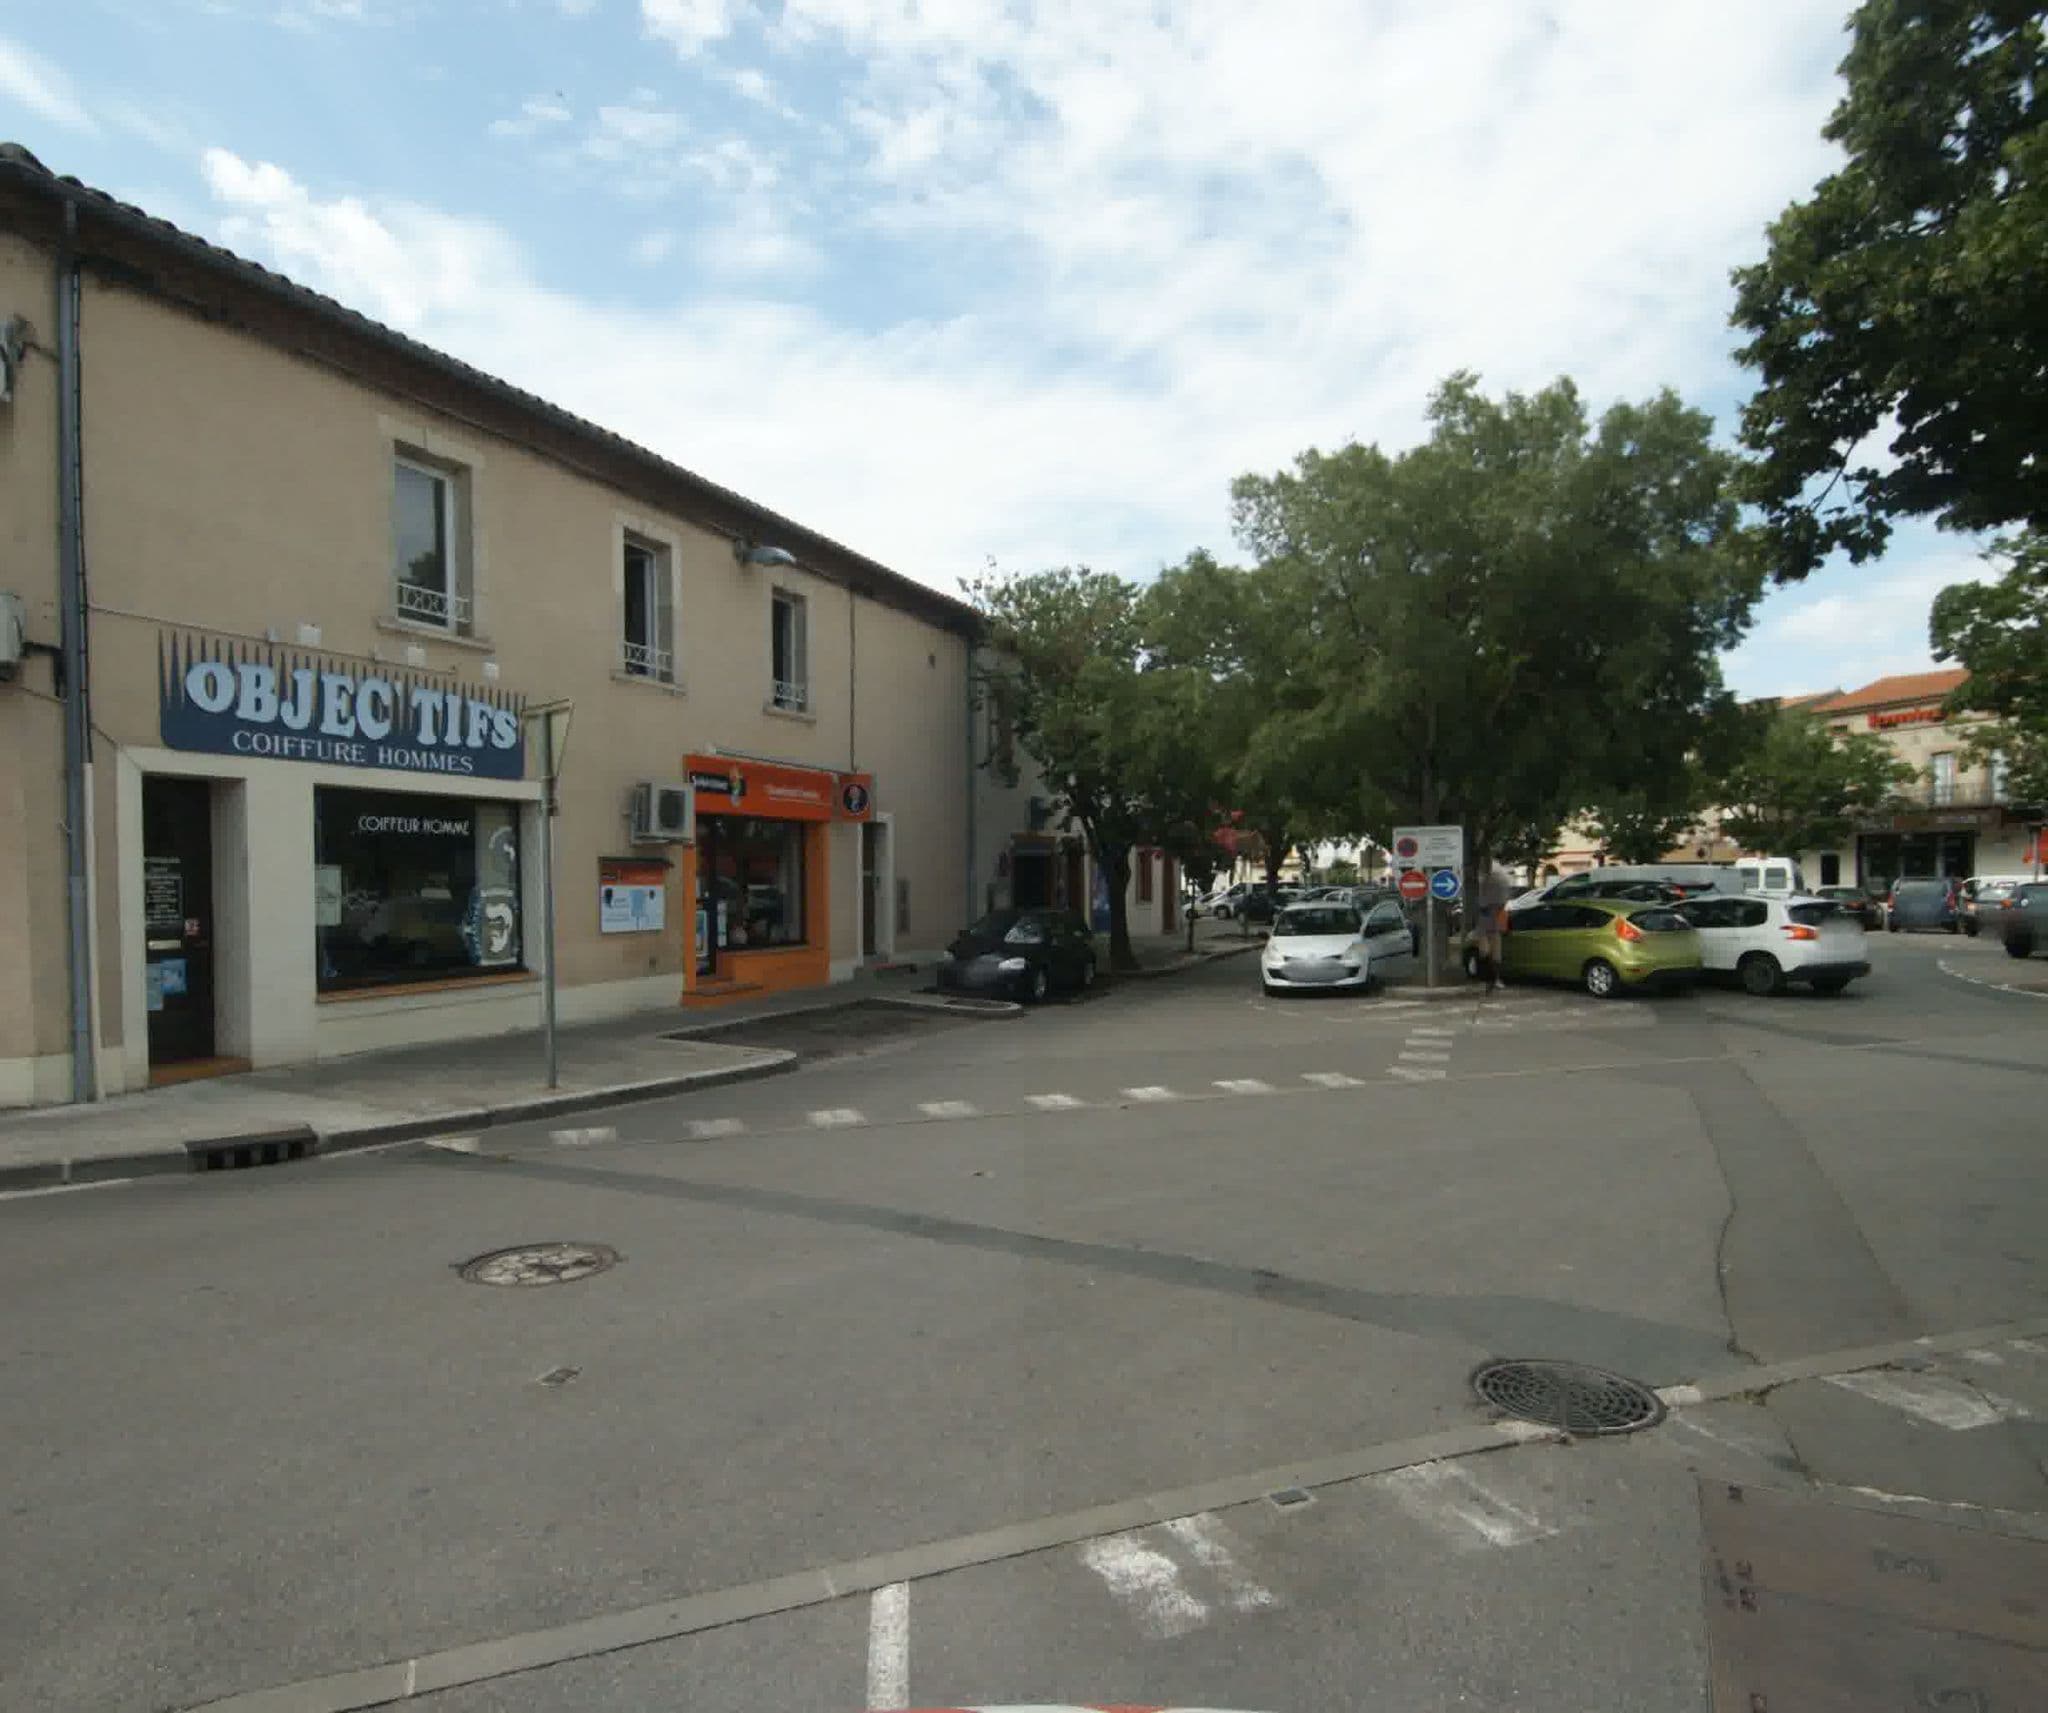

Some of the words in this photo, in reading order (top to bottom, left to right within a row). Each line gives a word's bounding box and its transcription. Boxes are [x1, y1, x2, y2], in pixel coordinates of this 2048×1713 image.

[232, 729, 366, 764] COIFFURE
[377, 746, 474, 774] HOMMES
[358, 815, 420, 833] COIFFEUR
[422, 818, 471, 836] HOMME
